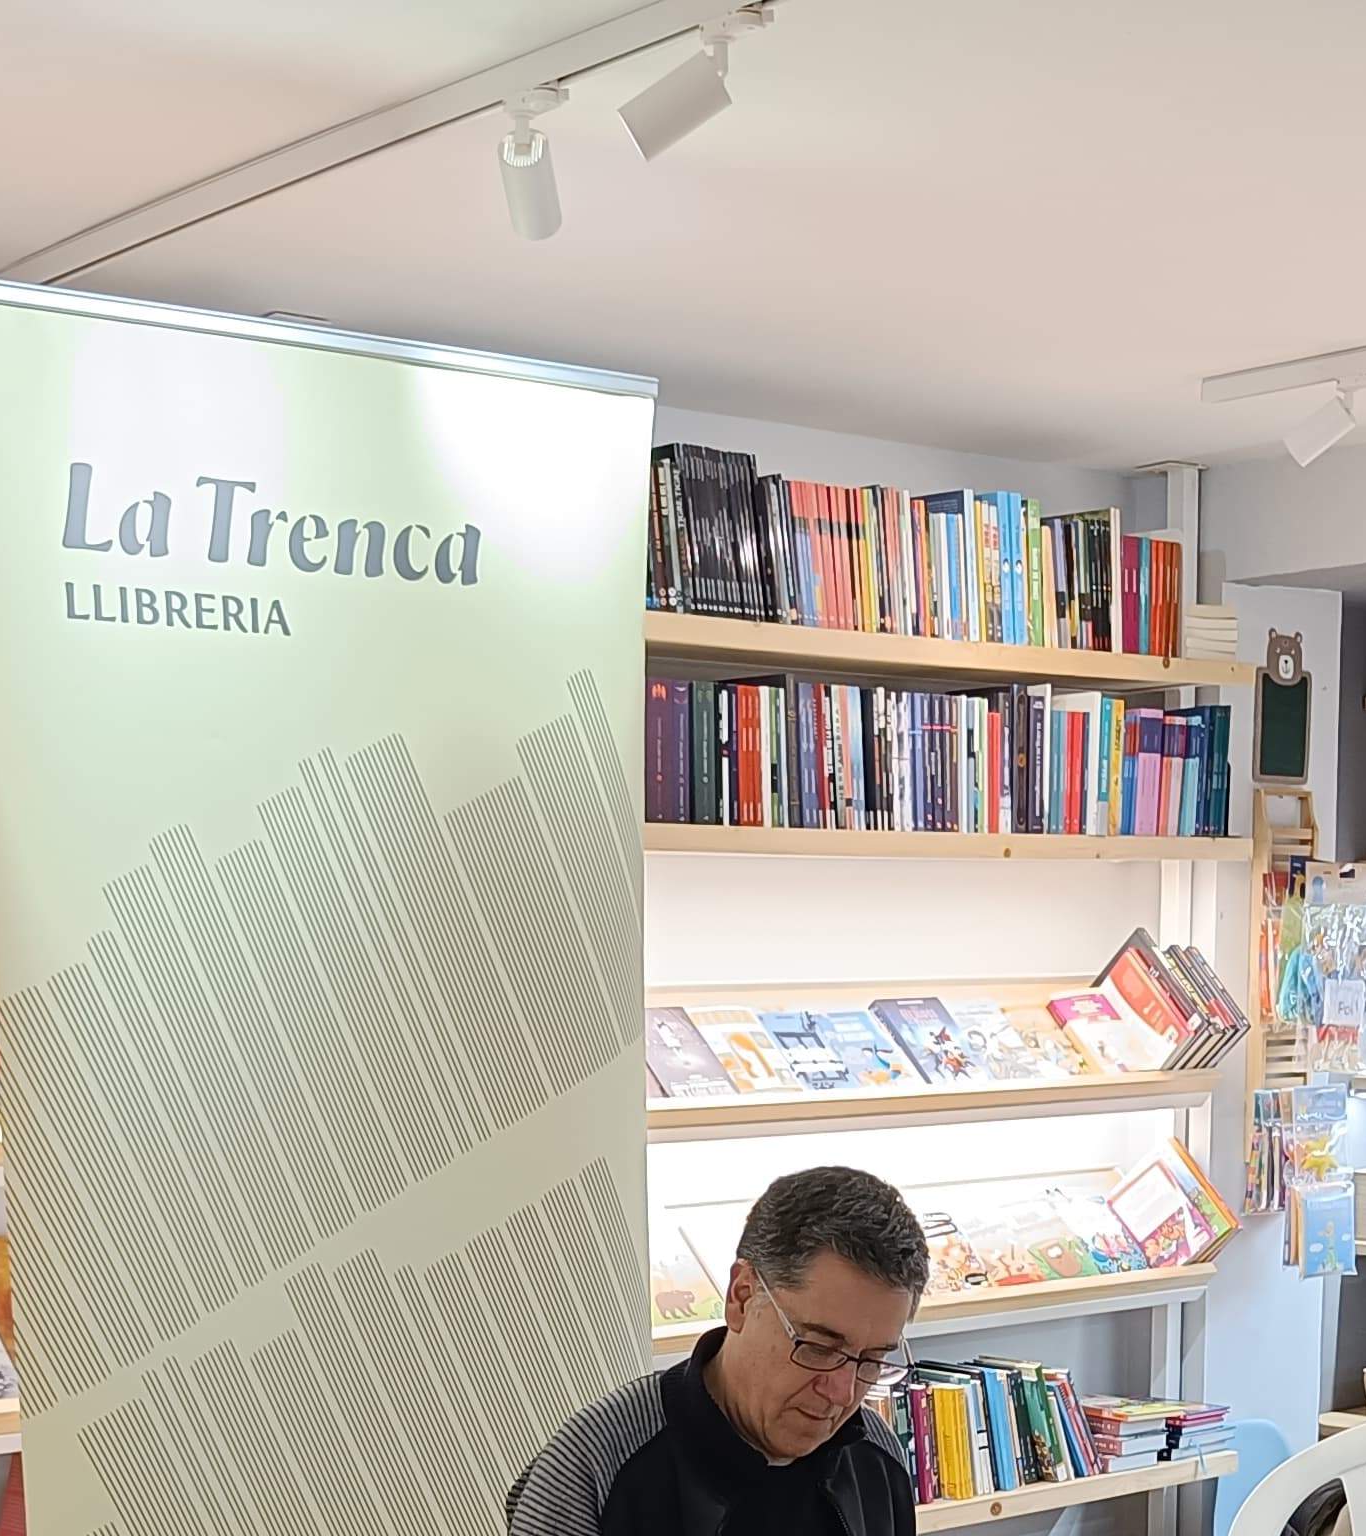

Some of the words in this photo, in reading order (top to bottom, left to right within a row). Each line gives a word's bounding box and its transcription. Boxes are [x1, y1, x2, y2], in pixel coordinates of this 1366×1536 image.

[62, 463, 172, 558] La
[196, 476, 481, 586] Trenca
[65, 582, 291, 637] LLIBRERIA
